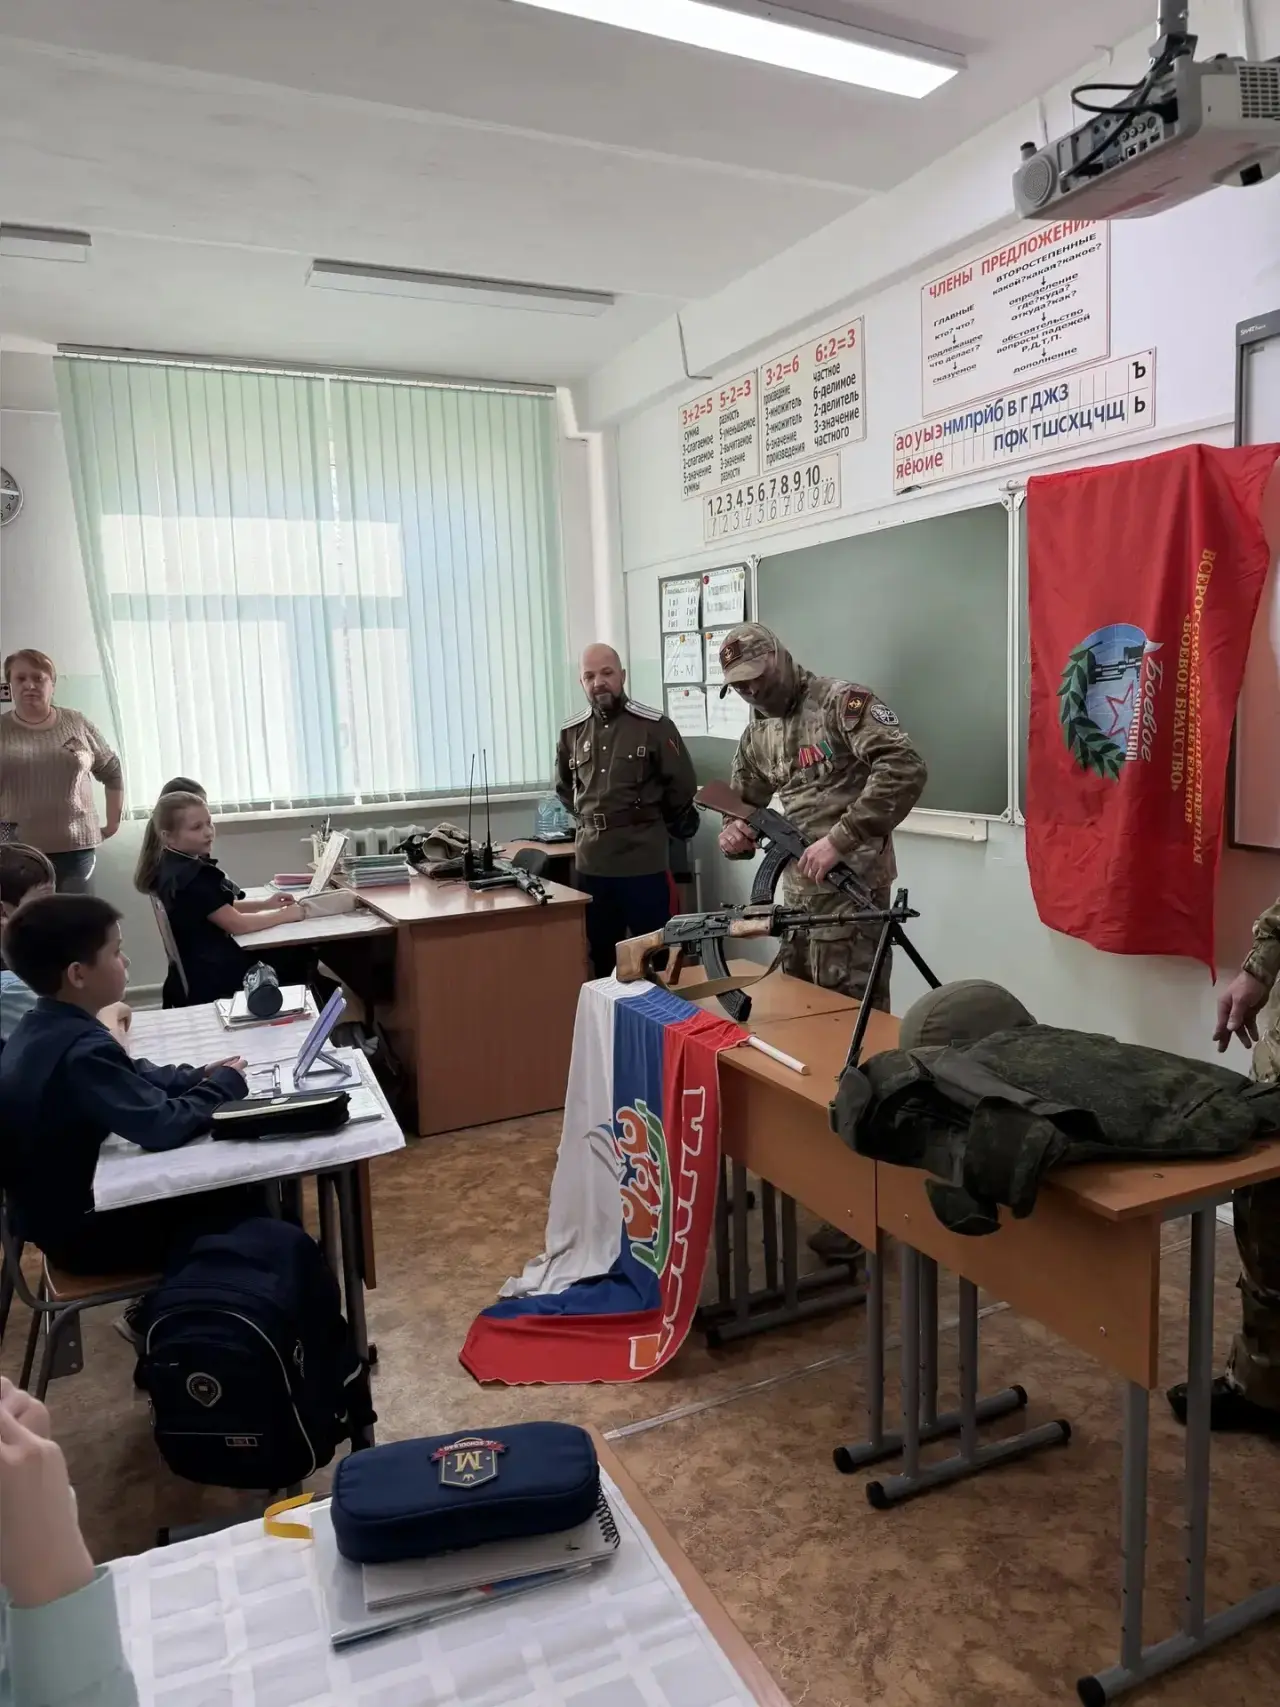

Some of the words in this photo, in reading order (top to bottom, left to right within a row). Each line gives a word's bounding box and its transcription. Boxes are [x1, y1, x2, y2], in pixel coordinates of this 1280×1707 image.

[996, 233, 1097, 283] ВТОРОСТЕПЕННЫЕ
[929, 267, 973, 298] ЧЛЕНЫ
[1009, 272, 1079, 305] определение
[933, 304, 975, 327] ГЛАВНЫЕ
[1002, 308, 1084, 344] обстоятельство
[927, 334, 983, 360] подлежащее
[935, 328, 953, 340] кто?
[996, 334, 1039, 354] вопросы
[1042, 314, 1091, 337] падежей
[813, 362, 841, 382] частное
[1013, 347, 1078, 373] дополнение
[813, 373, 856, 399] 6-делимое
[813, 390, 859, 417] 2-делитель
[814, 407, 860, 434] 3-значение
[814, 426, 850, 447] частного
[1140, 655, 1163, 763] Боевое
[1185, 723, 1196, 823] ВЕТЕРАНОВ
